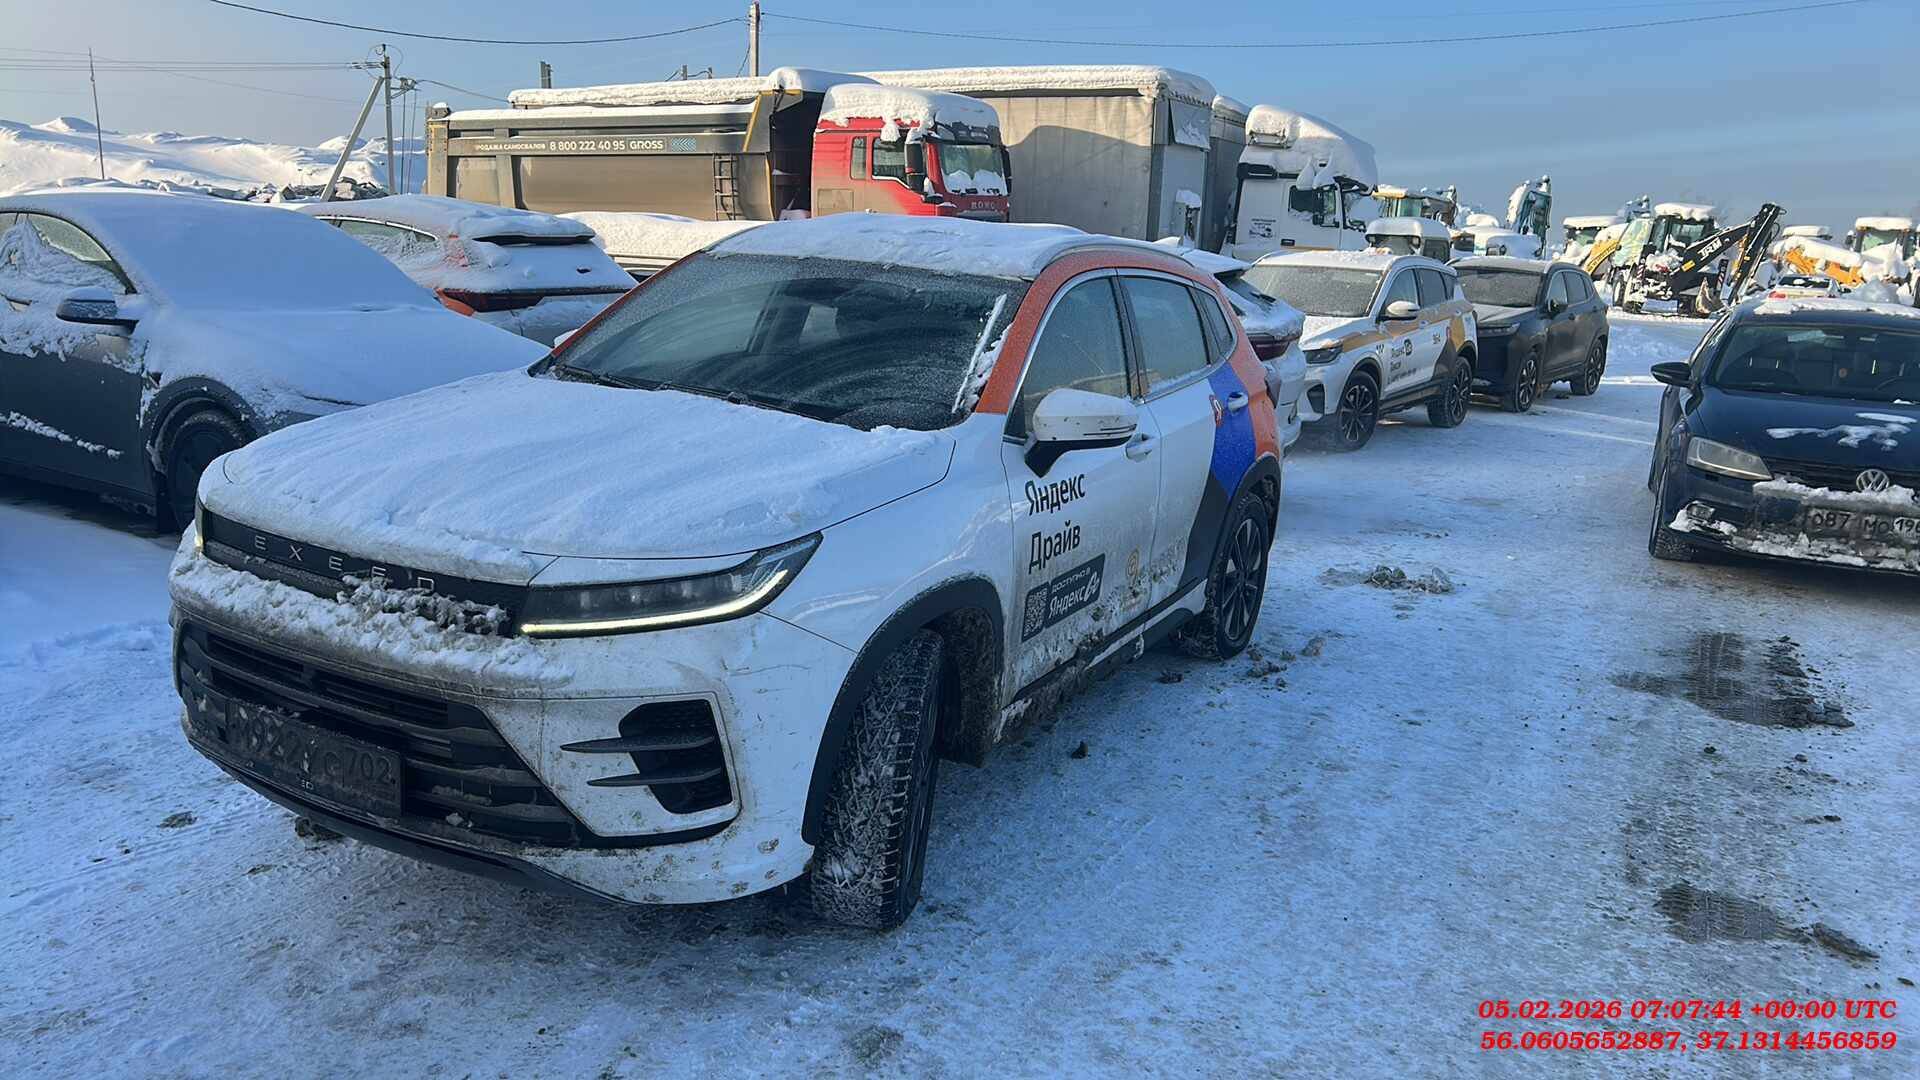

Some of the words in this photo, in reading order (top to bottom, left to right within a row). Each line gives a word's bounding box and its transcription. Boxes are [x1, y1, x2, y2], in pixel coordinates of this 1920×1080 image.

[549, 140, 557, 151] 8
[558, 140, 577, 151] 800
[579, 140, 596, 151] 222
[598, 139, 611, 151] 40
[612, 139, 626, 151] 95
[629, 139, 665, 150] GROSS
[1024, 474, 1086, 516] Яндекс
[253, 534, 436, 593] EXEED
[1028, 519, 1081, 575] Драйв
[1048, 585, 1086, 619] Яндекс
